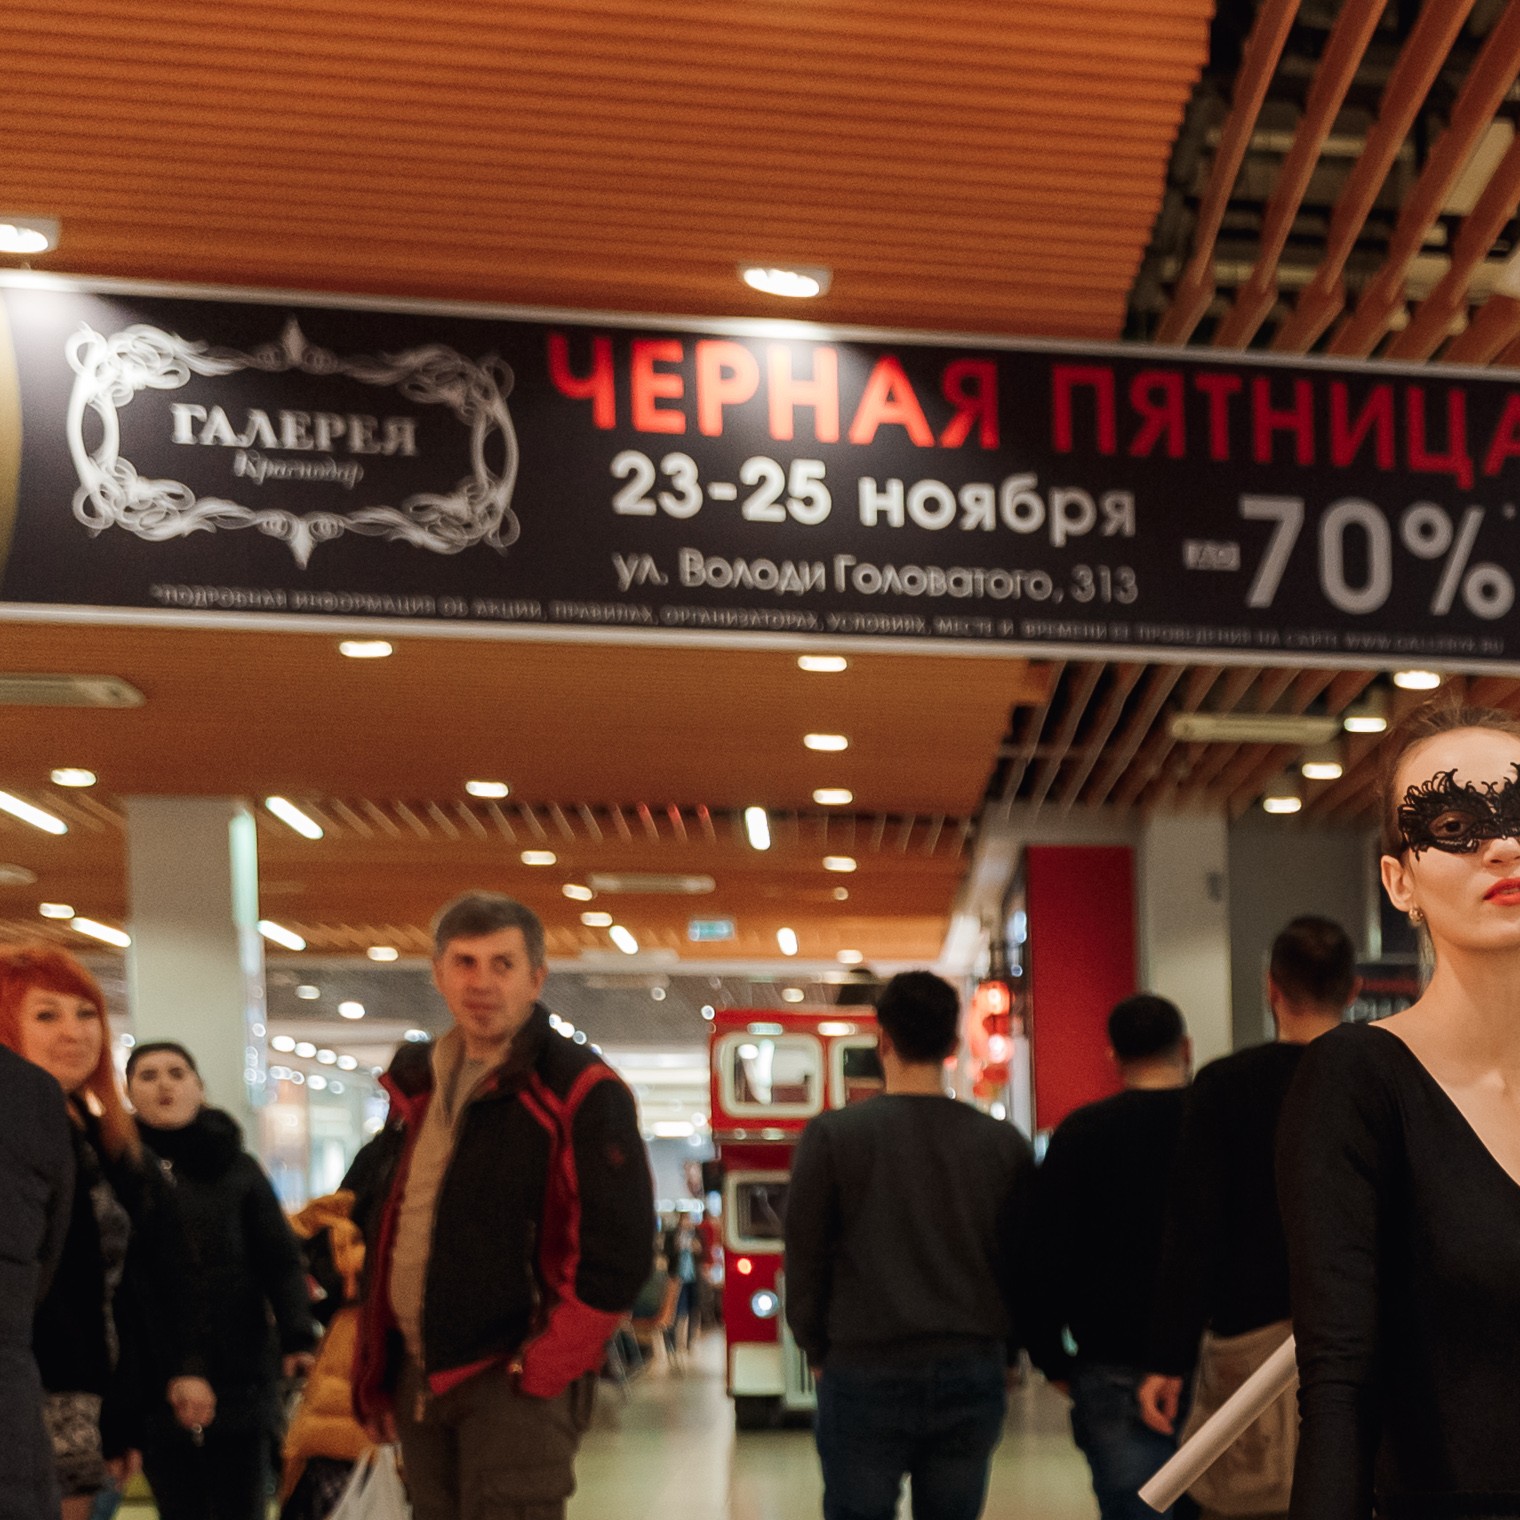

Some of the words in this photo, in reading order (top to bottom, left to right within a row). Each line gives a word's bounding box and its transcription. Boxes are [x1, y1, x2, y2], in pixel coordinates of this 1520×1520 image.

[547, 332, 999, 449] ЧЕРНАЯ
[170, 403, 416, 456] ГАЛЕРЕЯ
[609, 449, 833, 525] 23-25
[857, 471, 1136, 547] ноября
[612, 552, 669, 592] ул.
[678, 547, 826, 596] Володи
[834, 554, 1065, 604] Головатого,
[1070, 564, 1138, 604] 313
